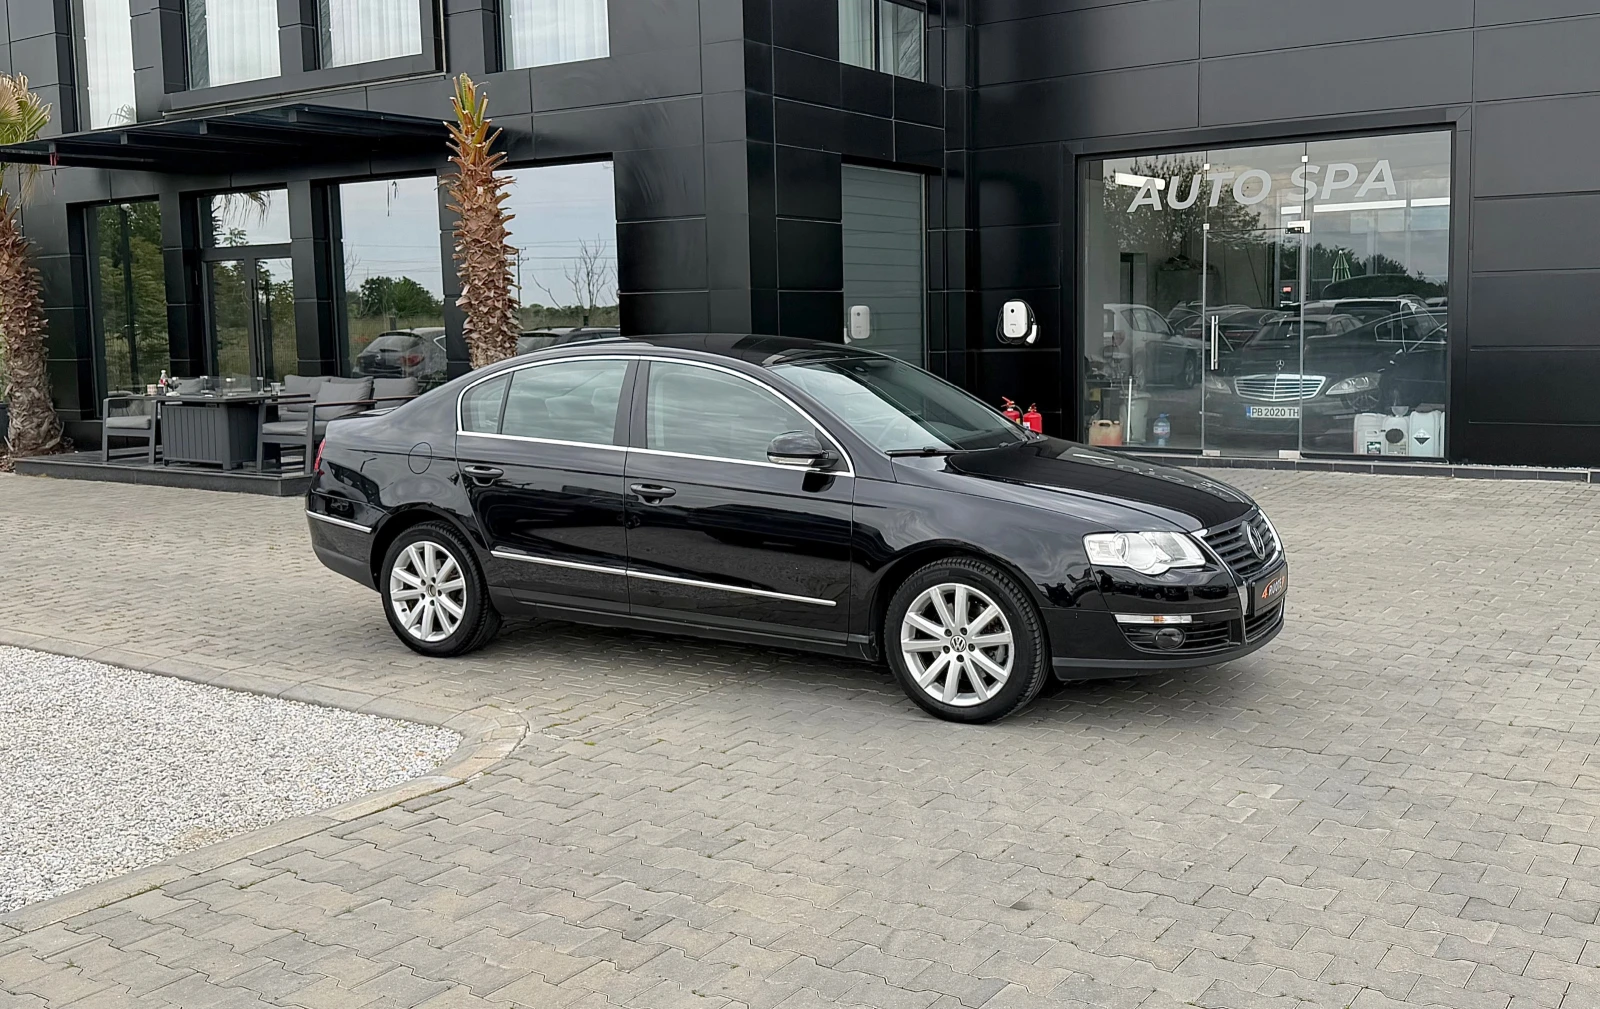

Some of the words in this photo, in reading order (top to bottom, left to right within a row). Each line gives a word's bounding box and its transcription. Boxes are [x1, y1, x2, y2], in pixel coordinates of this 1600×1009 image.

[1127, 169, 1272, 213] AUTO
[1287, 160, 1397, 201] SPA
[1251, 408, 1263, 417] PB
[1264, 408, 1286, 417] 2020
[1287, 408, 1300, 417] TH
